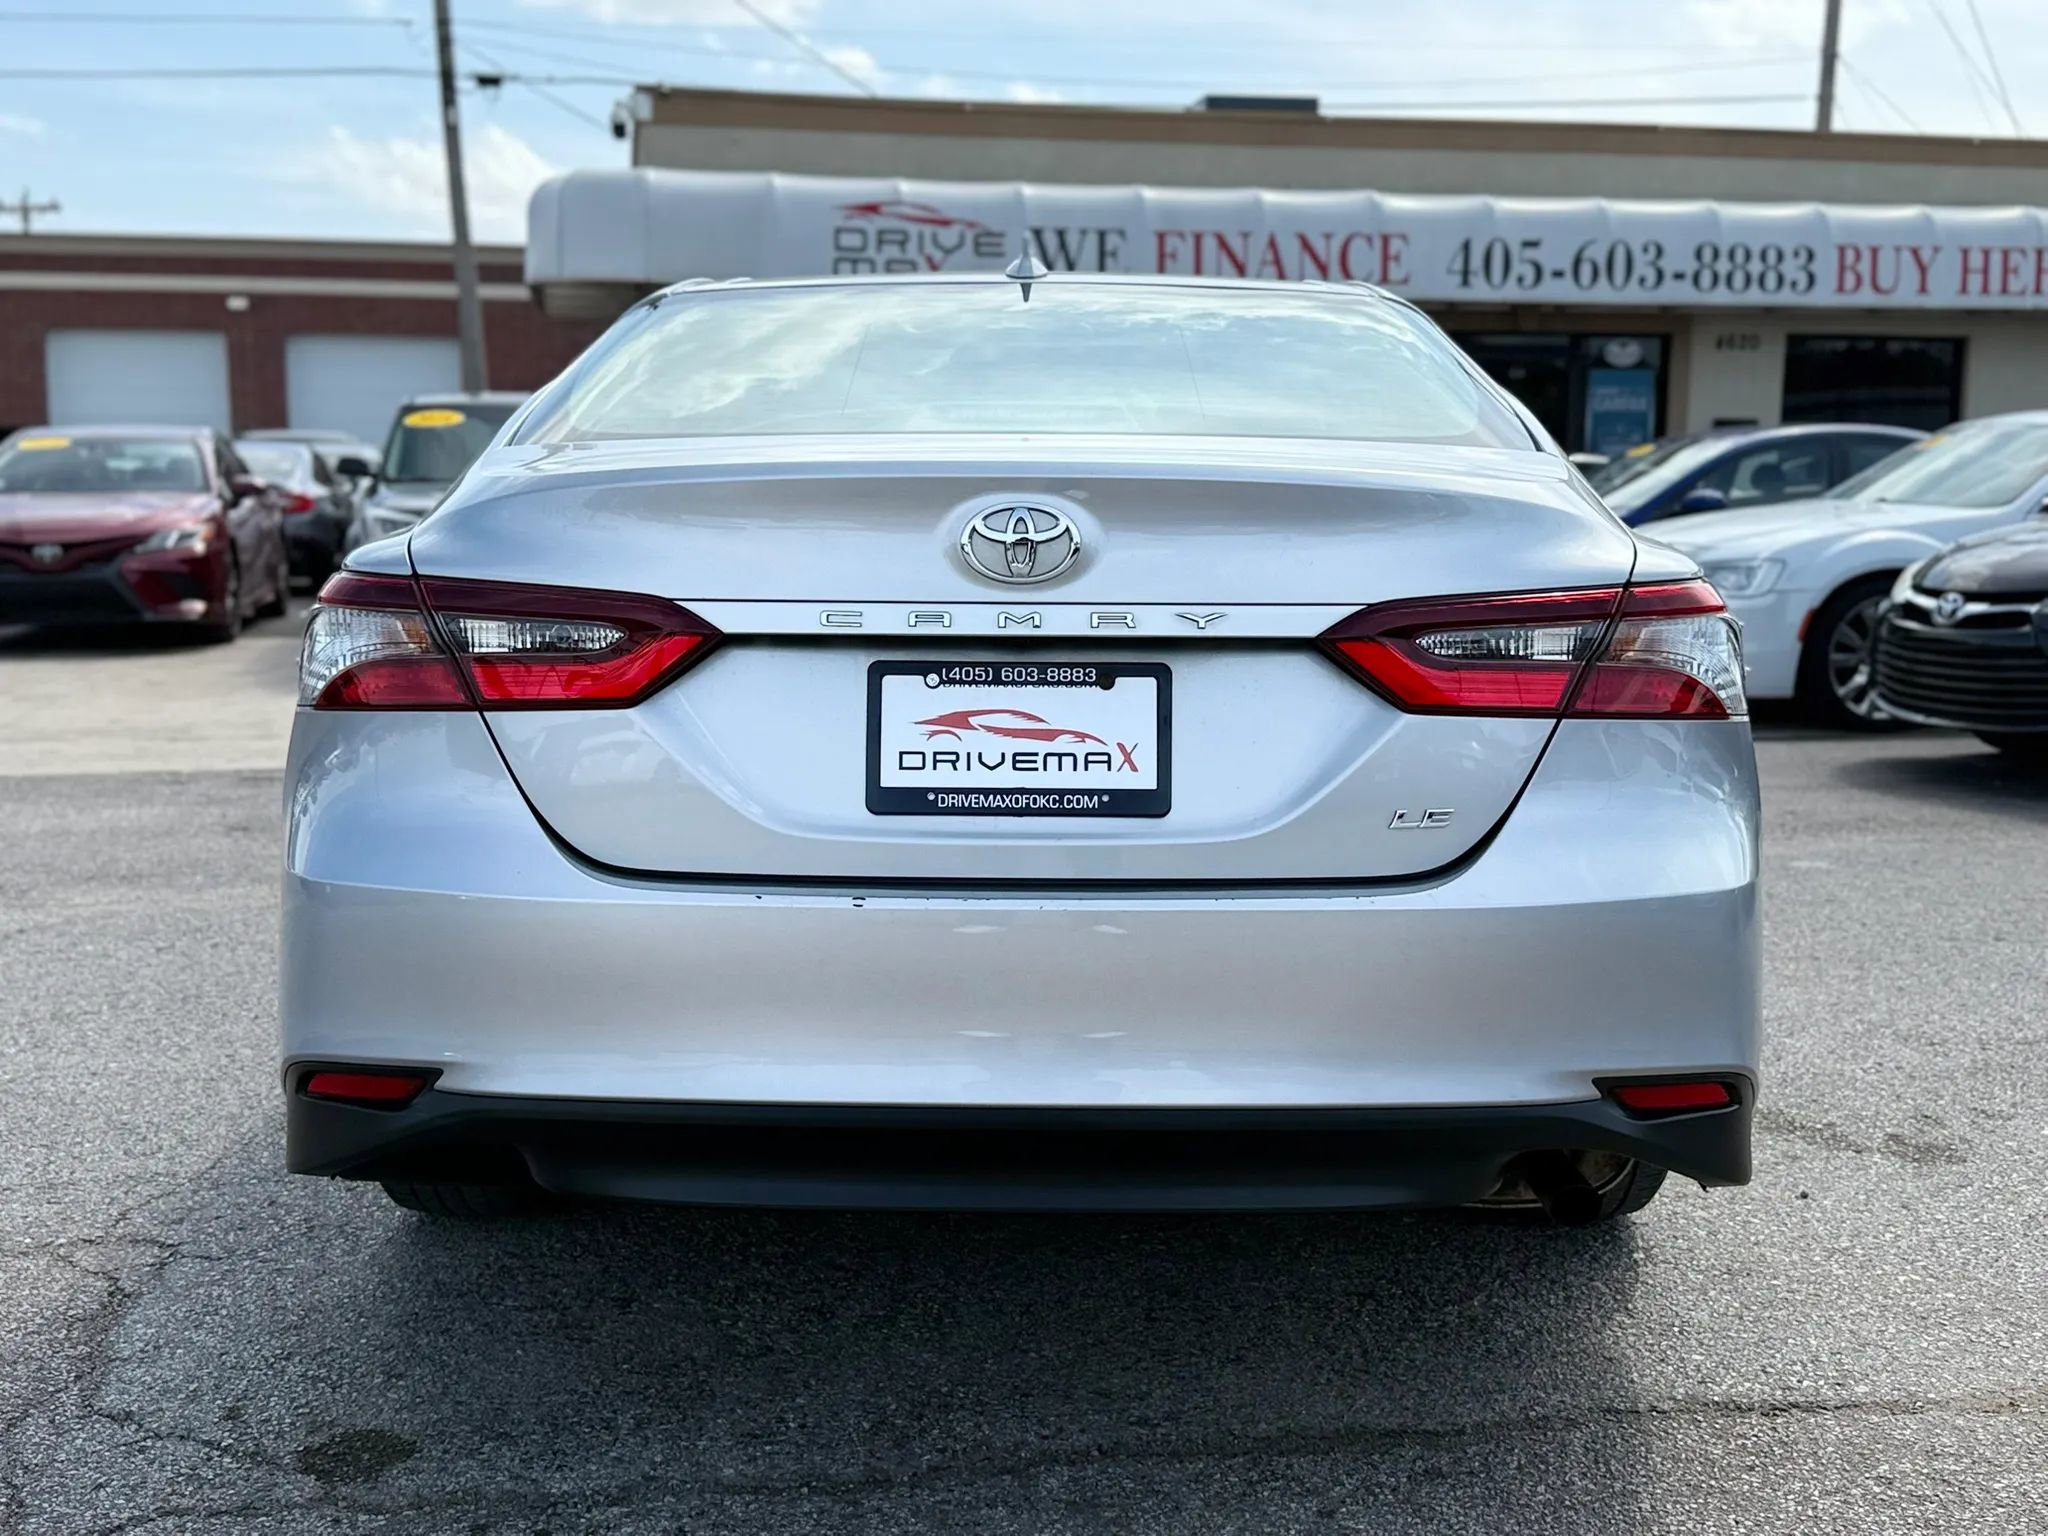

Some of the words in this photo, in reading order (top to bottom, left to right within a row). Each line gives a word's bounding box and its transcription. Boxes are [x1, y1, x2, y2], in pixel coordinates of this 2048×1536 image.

[834, 226, 1006, 258] DRIVE
[1029, 226, 1129, 274] WE
[1153, 229, 1416, 286] FINANCE
[1446, 236, 1817, 295] 405-603-8883
[1834, 242, 1943, 296] BUY
[819, 610, 1229, 630] CAMRY
[942, 667, 993, 682] (405)
[1001, 667, 1096, 683] 603-8883
[898, 742, 1139, 773] DRIVEMAX
[937, 793, 1099, 809] DRIVEMAXOFOKC.COM
[1388, 808, 1455, 829] LE
